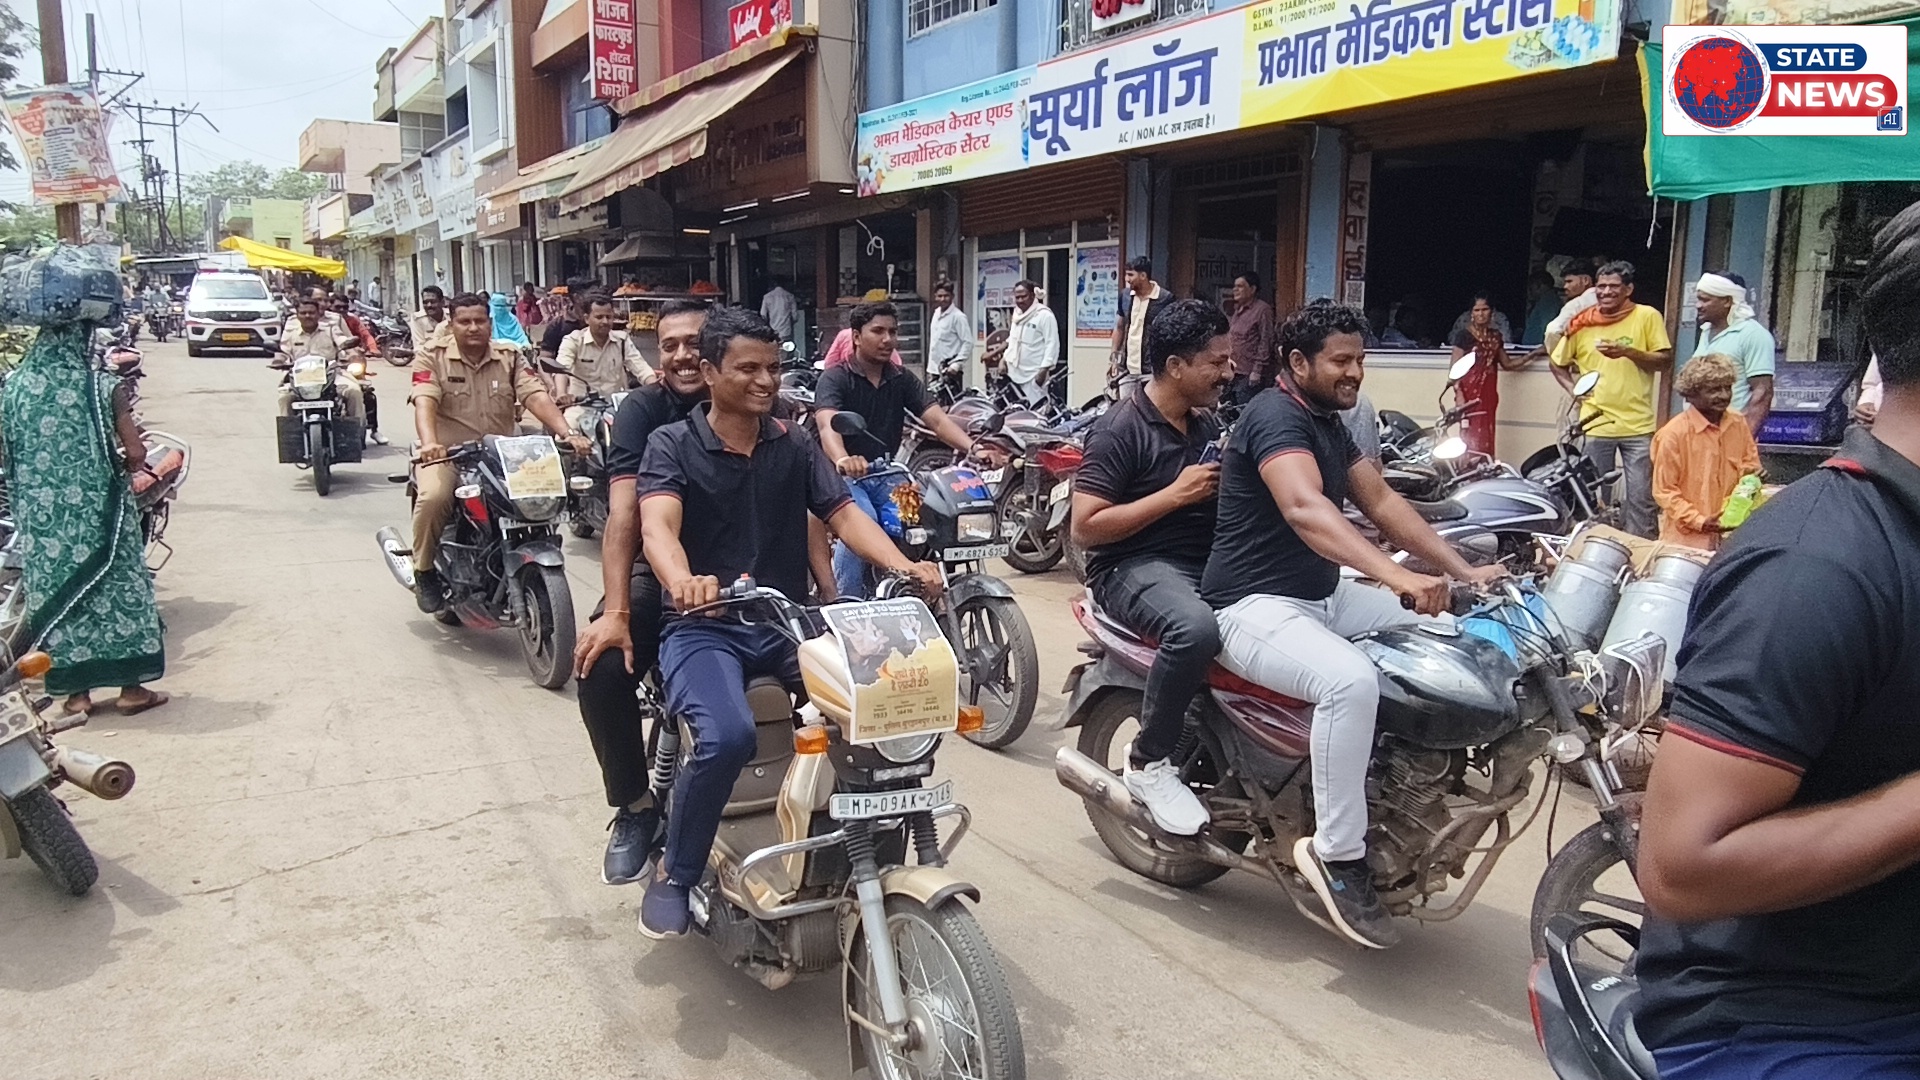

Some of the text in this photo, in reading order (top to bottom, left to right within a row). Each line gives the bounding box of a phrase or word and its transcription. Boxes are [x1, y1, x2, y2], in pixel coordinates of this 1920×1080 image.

[1252, 6, 1273, 20] GSTIN
[1258, 26, 1331, 86] प्रभात
[1336, 0, 1453, 65] मेडिकल
[1029, 38, 1218, 156] सूर्या लॉज
[873, 130, 899, 148] अमन
[903, 119, 945, 141] मेडिकल
[1118, 131, 1128, 144] AC
[1136, 126, 1155, 140] NON
[1157, 122, 1168, 136] AC
[842, 608, 859, 617] SAY
[876, 603, 888, 612] TO
